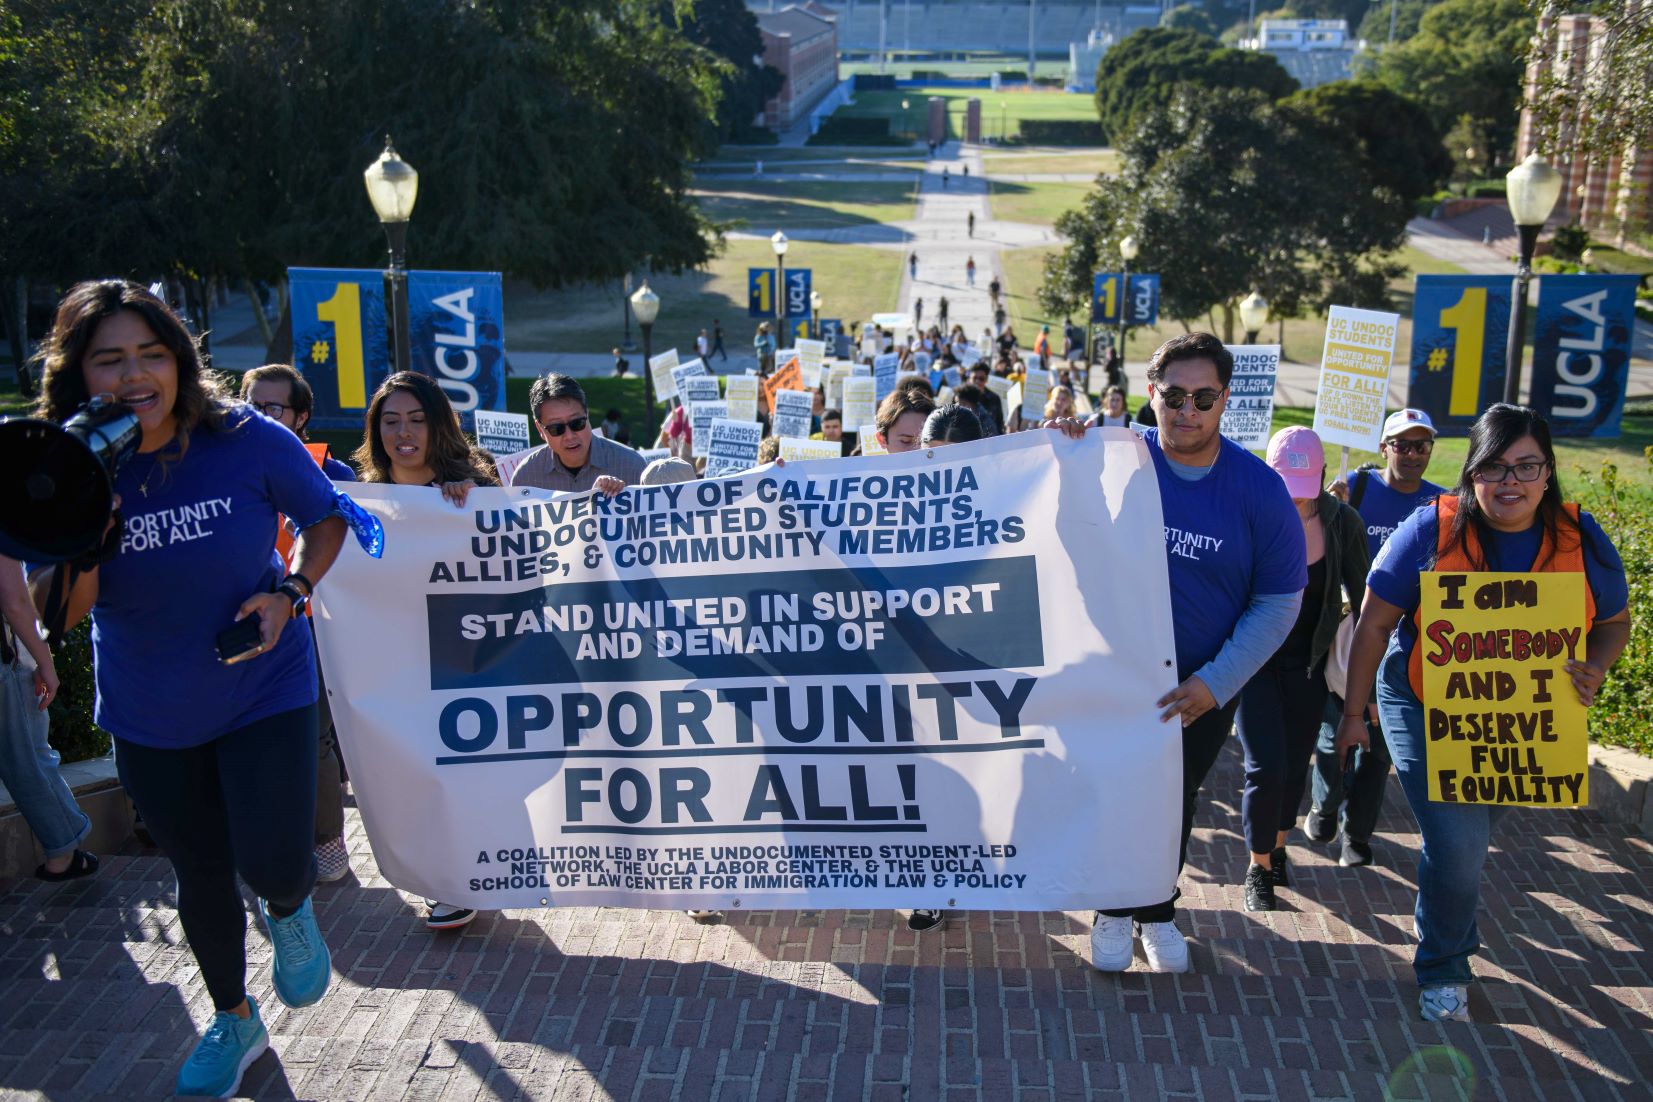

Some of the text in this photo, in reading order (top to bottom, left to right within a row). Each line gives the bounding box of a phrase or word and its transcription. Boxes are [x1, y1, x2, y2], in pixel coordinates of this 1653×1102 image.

[790, 273, 805, 312] UCLA
[1135, 279, 1152, 319] UCLA
[824, 322, 836, 354] UCLA
[1329, 329, 1393, 349] STUDENTS
[1331, 317, 1394, 337] UC UNDOC
[311, 282, 366, 408] #1
[432, 287, 479, 411] UCLA
[1331, 347, 1384, 364] UNITED FOR
[1427, 287, 1487, 416] #1
[1551, 289, 1608, 418] UCLA
[1232, 364, 1276, 373] DENTS
[1326, 355, 1387, 373] OPPORTUNITY
[1323, 372, 1385, 394] FOR ALL!
[1238, 399, 1271, 409] ALL!
[1366, 395, 1381, 404] THE
[1374, 403, 1383, 412] TO
[478, 418, 527, 430] UC UNDOC
[478, 426, 527, 437] STUDENTS
[729, 426, 760, 436] UNDOC
[483, 438, 523, 448] UNITED FOR
[712, 431, 759, 442] STUDENTS
[714, 442, 739, 450] UNITED
[709, 458, 729, 467] FOR
[711, 447, 756, 457] OPPORTUNITY
[801, 448, 839, 457] UNDOC
[475, 466, 979, 535] UNIVERSITY OF CALIFORNIA
[124, 497, 232, 534] ORTUNITY
[471, 495, 983, 558] UNDOCUMENTED STUDENTS,
[169, 521, 213, 544] ALL.
[1164, 526, 1223, 552] RTUNITY
[429, 516, 1026, 583] ALLIES, & COMMUNITY MEMBERS
[1438, 574, 1538, 610] I am
[461, 583, 1000, 640] STAND UNITED IN SUPPORT
[575, 621, 884, 661] AND DEMAND OF
[1426, 620, 1581, 666] SOMEBODY
[1445, 669, 1553, 703] AND I
[439, 677, 1038, 753] OPPORTUNITY
[1429, 708, 1558, 744] DESERVE
[1471, 745, 1543, 775] FULL
[564, 764, 920, 824] FOR ALL!
[1438, 770, 1584, 803] EQUALITY
[477, 845, 1017, 864] A COALITION LED BY THE UNDOCUMENTED STUDENT-LED
[511, 860, 984, 876] NETWORK, THE UCLA LABOR CENTER, & THE UCLA
[469, 873, 1027, 891] SCHOOL OF LAW CENTER FOR IMMIGRATION LAW & POLICY
